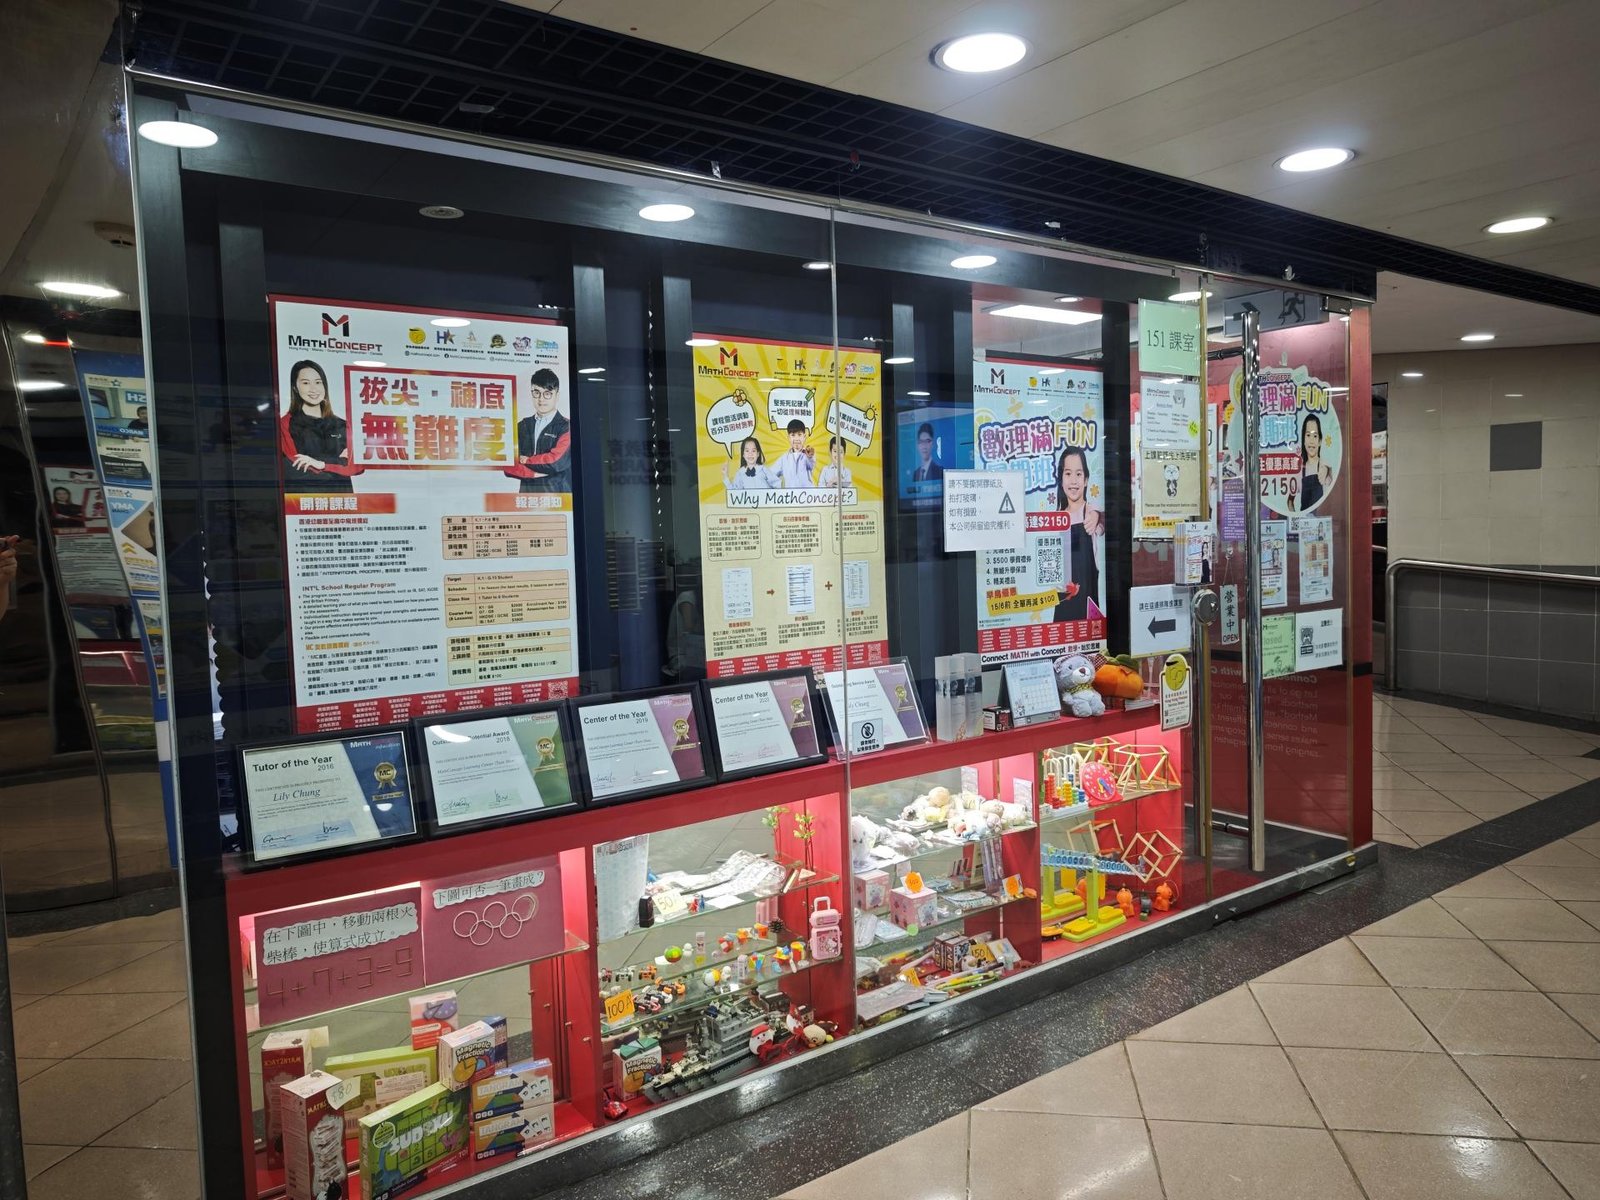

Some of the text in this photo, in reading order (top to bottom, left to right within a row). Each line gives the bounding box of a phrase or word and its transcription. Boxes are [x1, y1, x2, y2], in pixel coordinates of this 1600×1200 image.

[288, 335, 382, 352] MATHCONCEPT
[1147, 330, 1195, 353] 151 課室
[698, 365, 759, 377] MATHCONCEPT
[1259, 373, 1291, 382] THCONCEPT
[974, 385, 1020, 396] MATHCONCEPT
[1260, 384, 1329, 413] 理滿FUN
[361, 412, 507, 463] 無難度
[1261, 477, 1298, 496] 2150
[730, 491, 853, 509] Why MathConcept?
[344, 583, 369, 591] Regular
[1039, 595, 1055, 605] $100
[1224, 590, 1235, 631] 營業中
[1223, 634, 1238, 643] OPEN
[981, 653, 1009, 663] Connect
[1010, 651, 1030, 660] MATH
[1041, 647, 1066, 657] Concept
[715, 690, 768, 704] Center of the Year
[583, 710, 647, 725] Center of the Year
[253, 755, 333, 773] Tutor of the Year
[318, 763, 334, 771] 2016
[292, 788, 321, 799] Chung
[266, 906, 413, 944] 在下圖中，移動兩根火
[267, 929, 396, 964] 柴棒，使算式成立。
[456, 1040, 491, 1057] Magnetic
[625, 1056, 658, 1069] Magnetic
